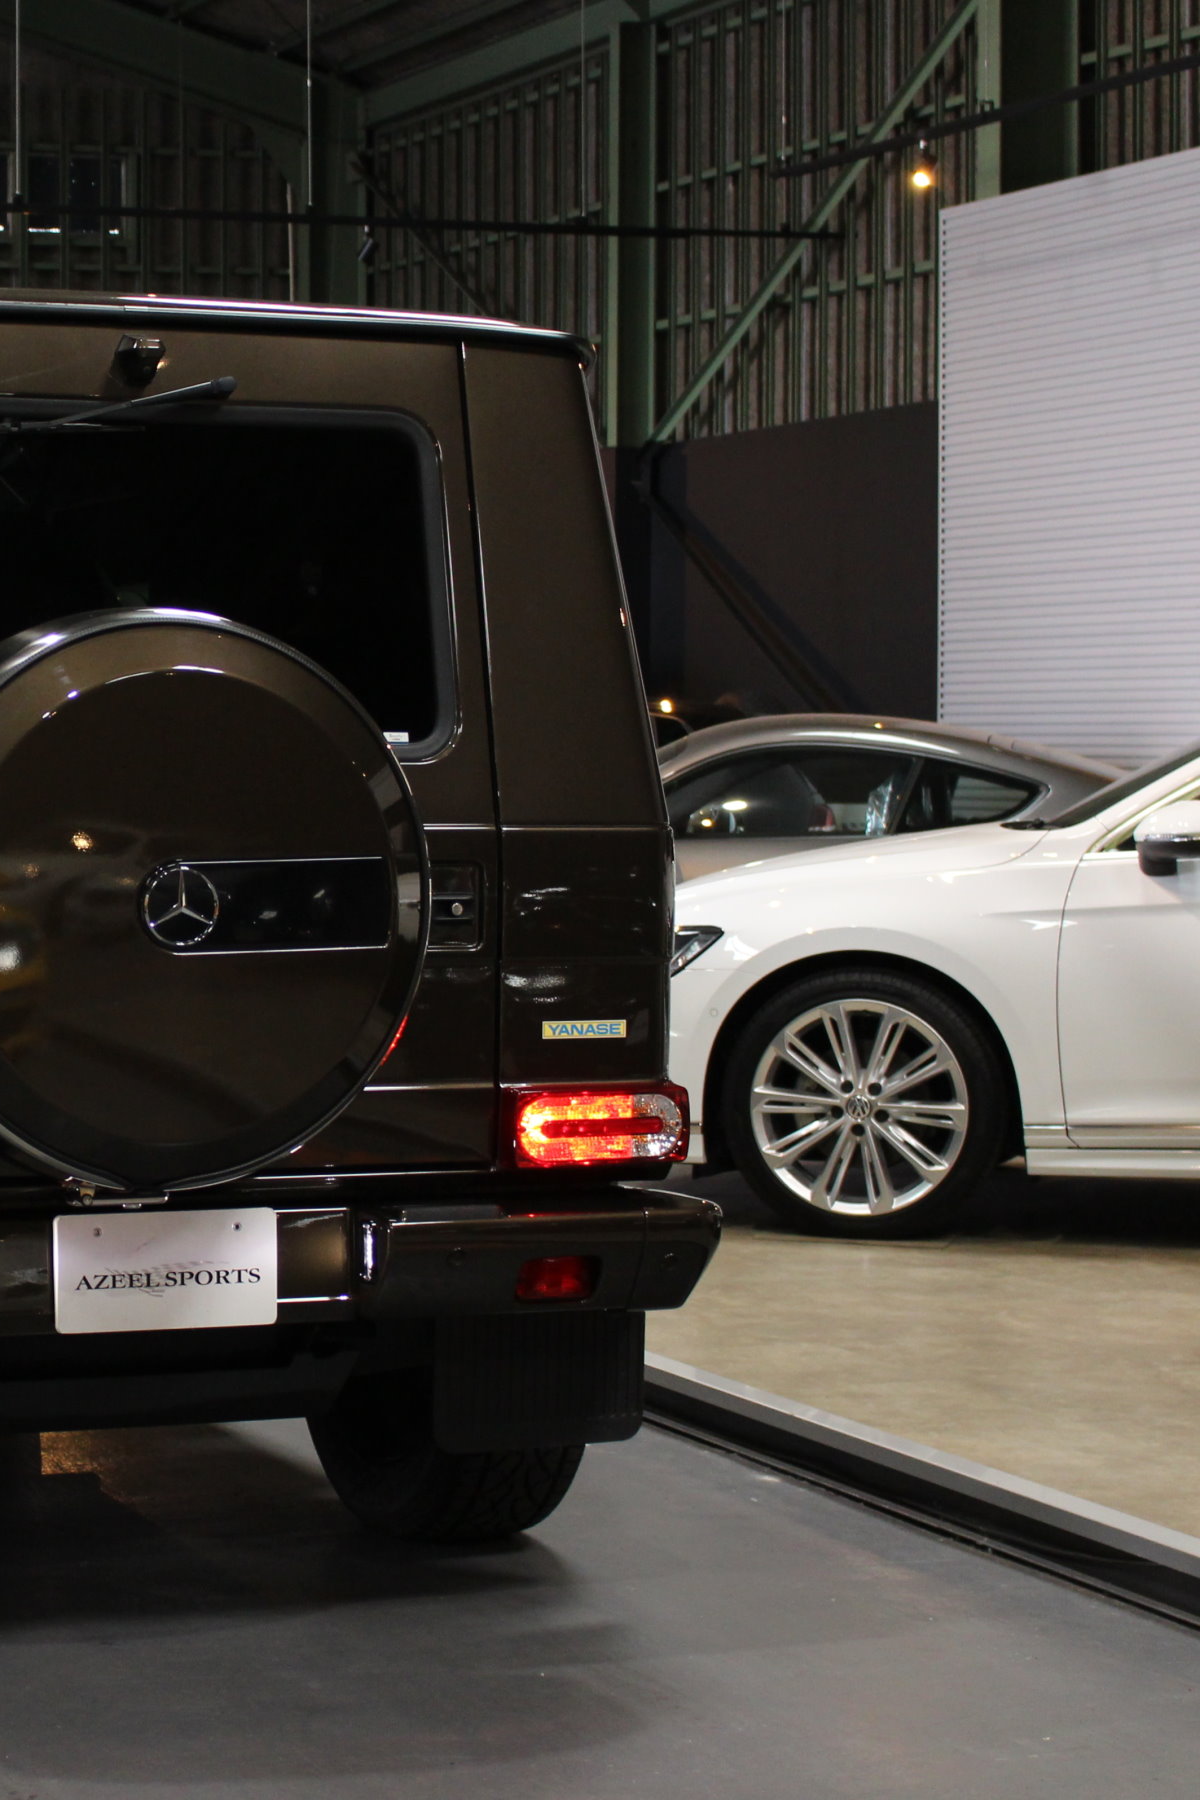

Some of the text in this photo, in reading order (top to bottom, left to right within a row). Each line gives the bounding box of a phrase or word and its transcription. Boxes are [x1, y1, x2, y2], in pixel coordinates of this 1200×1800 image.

[548, 1023, 621, 1036] YANASE
[75, 1267, 261, 1291] AZEEL SPORTS
